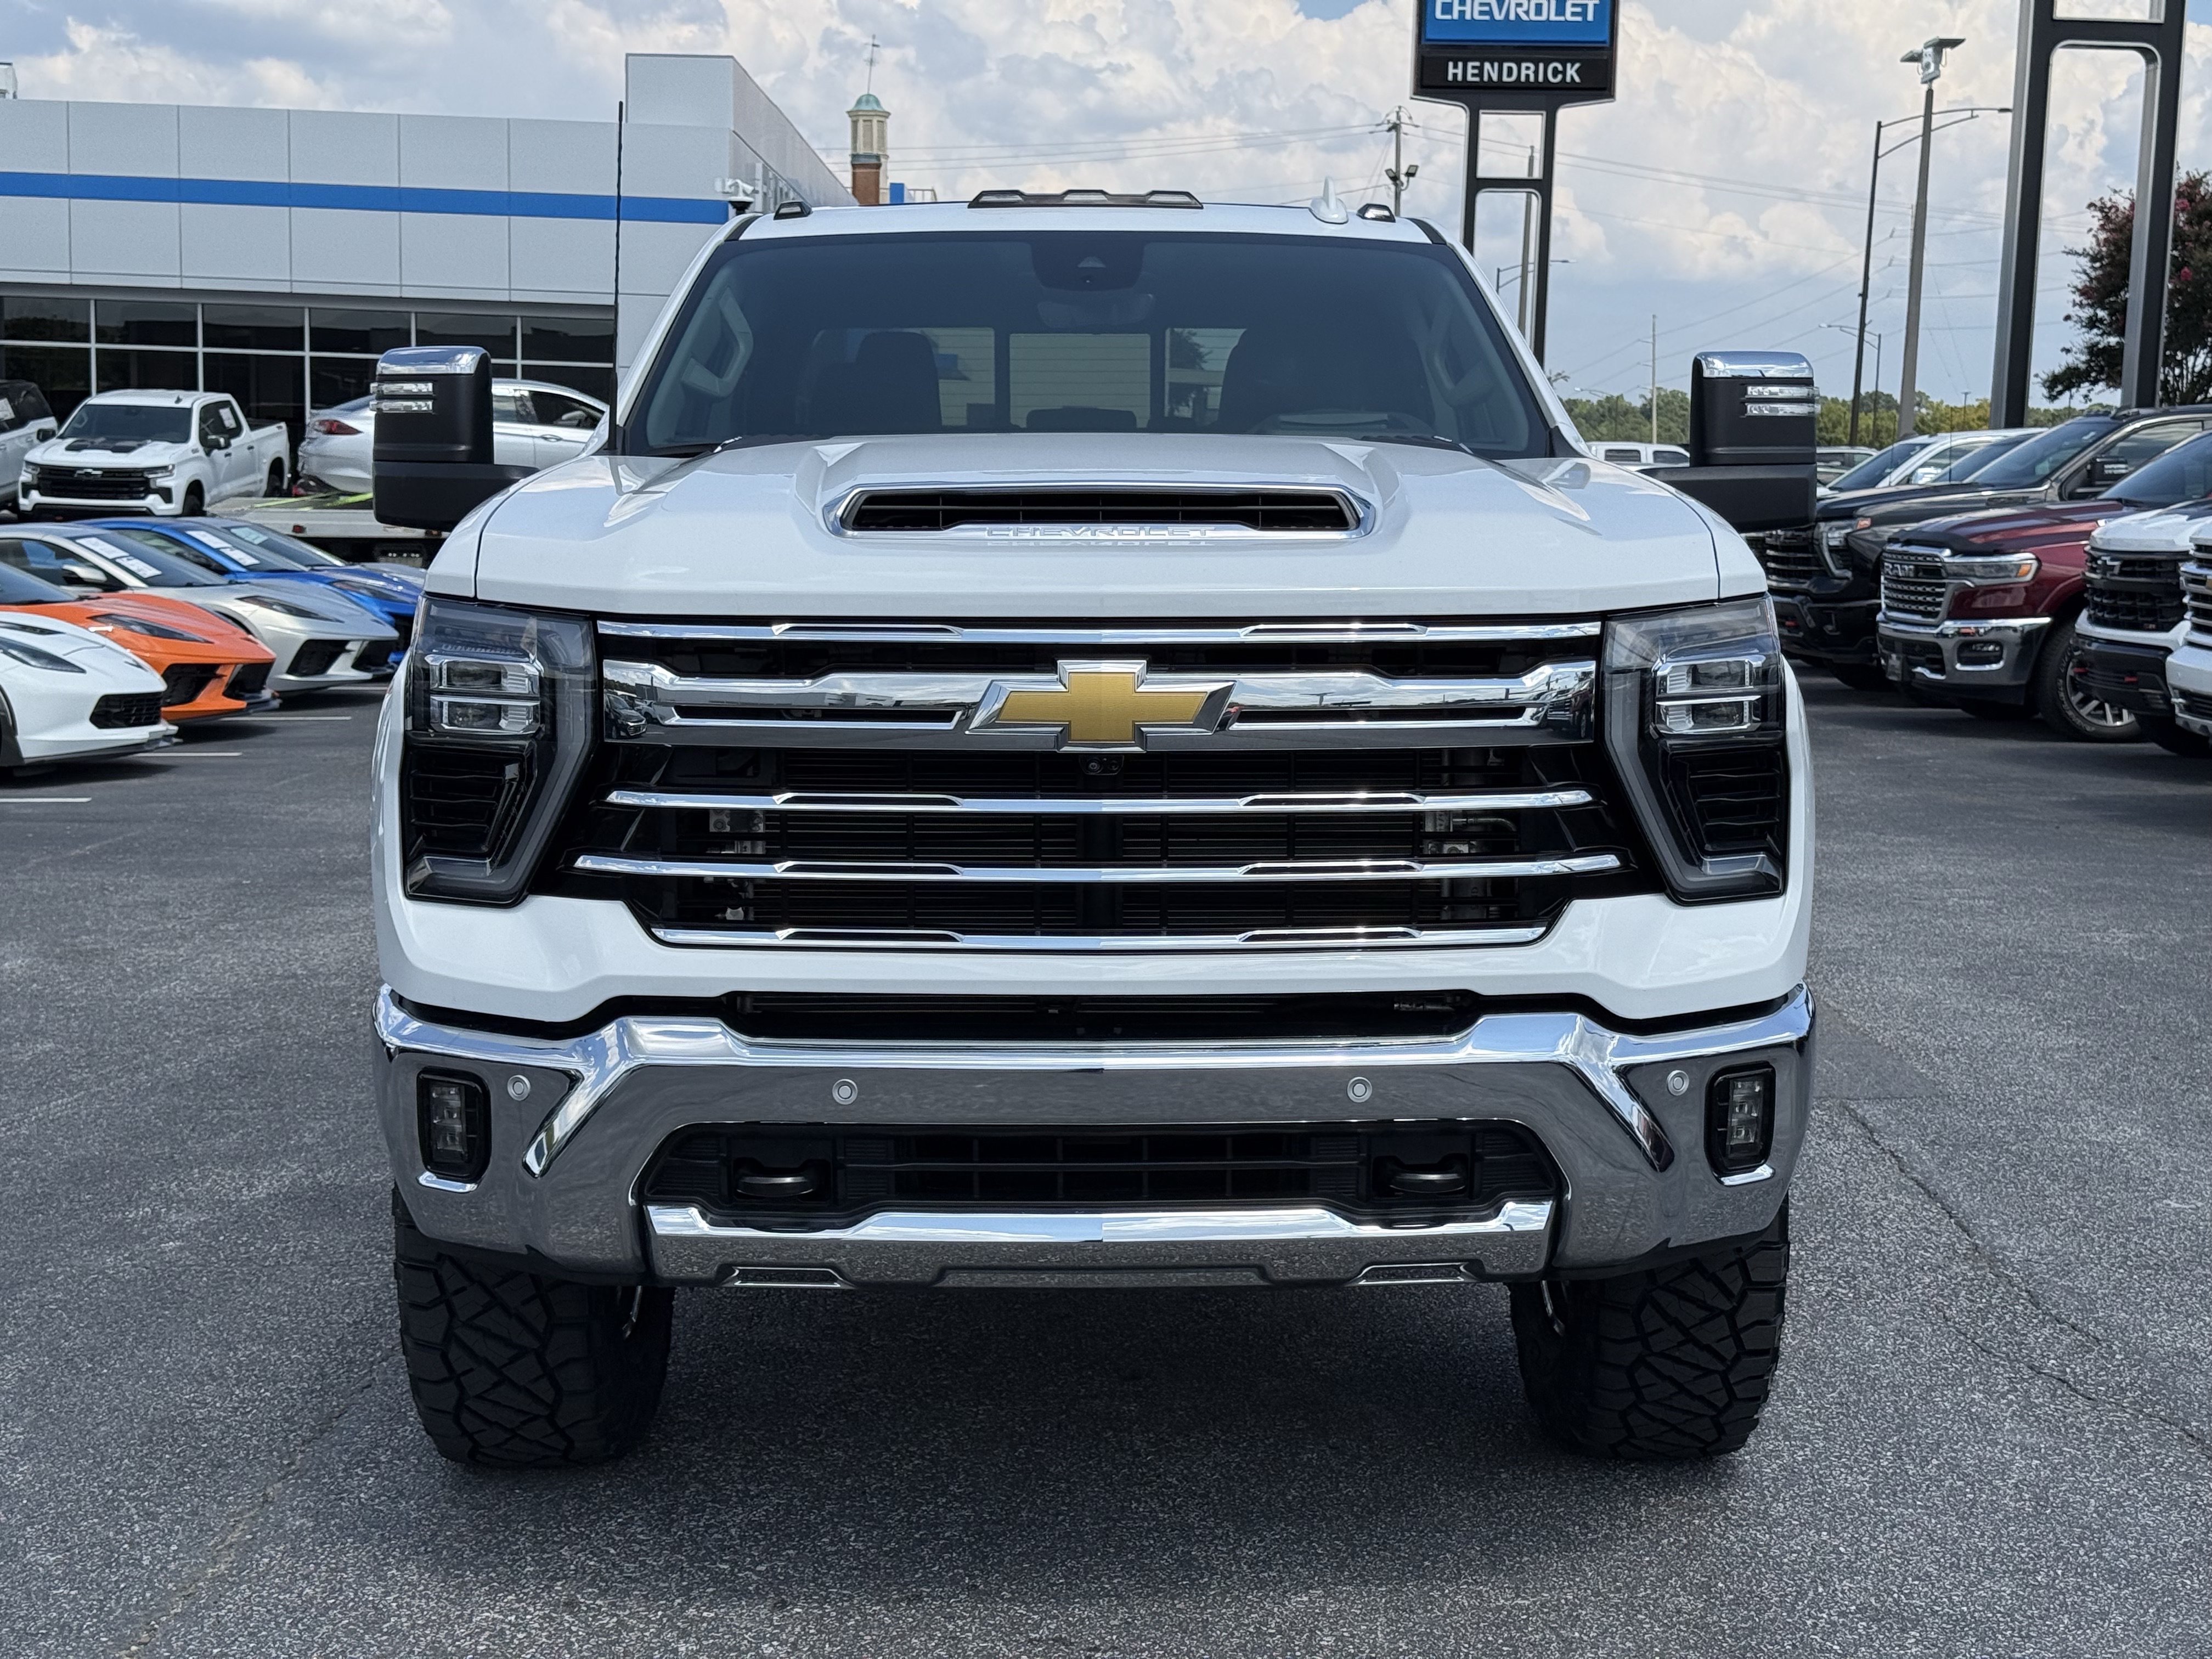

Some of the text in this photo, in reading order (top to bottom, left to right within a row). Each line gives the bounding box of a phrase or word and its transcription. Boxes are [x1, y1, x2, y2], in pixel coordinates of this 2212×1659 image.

[1435, 0, 1600, 21] CHEVROLET
[1447, 61, 1581, 83] HENDRICK
[985, 526, 1216, 537] CHEVROLET
